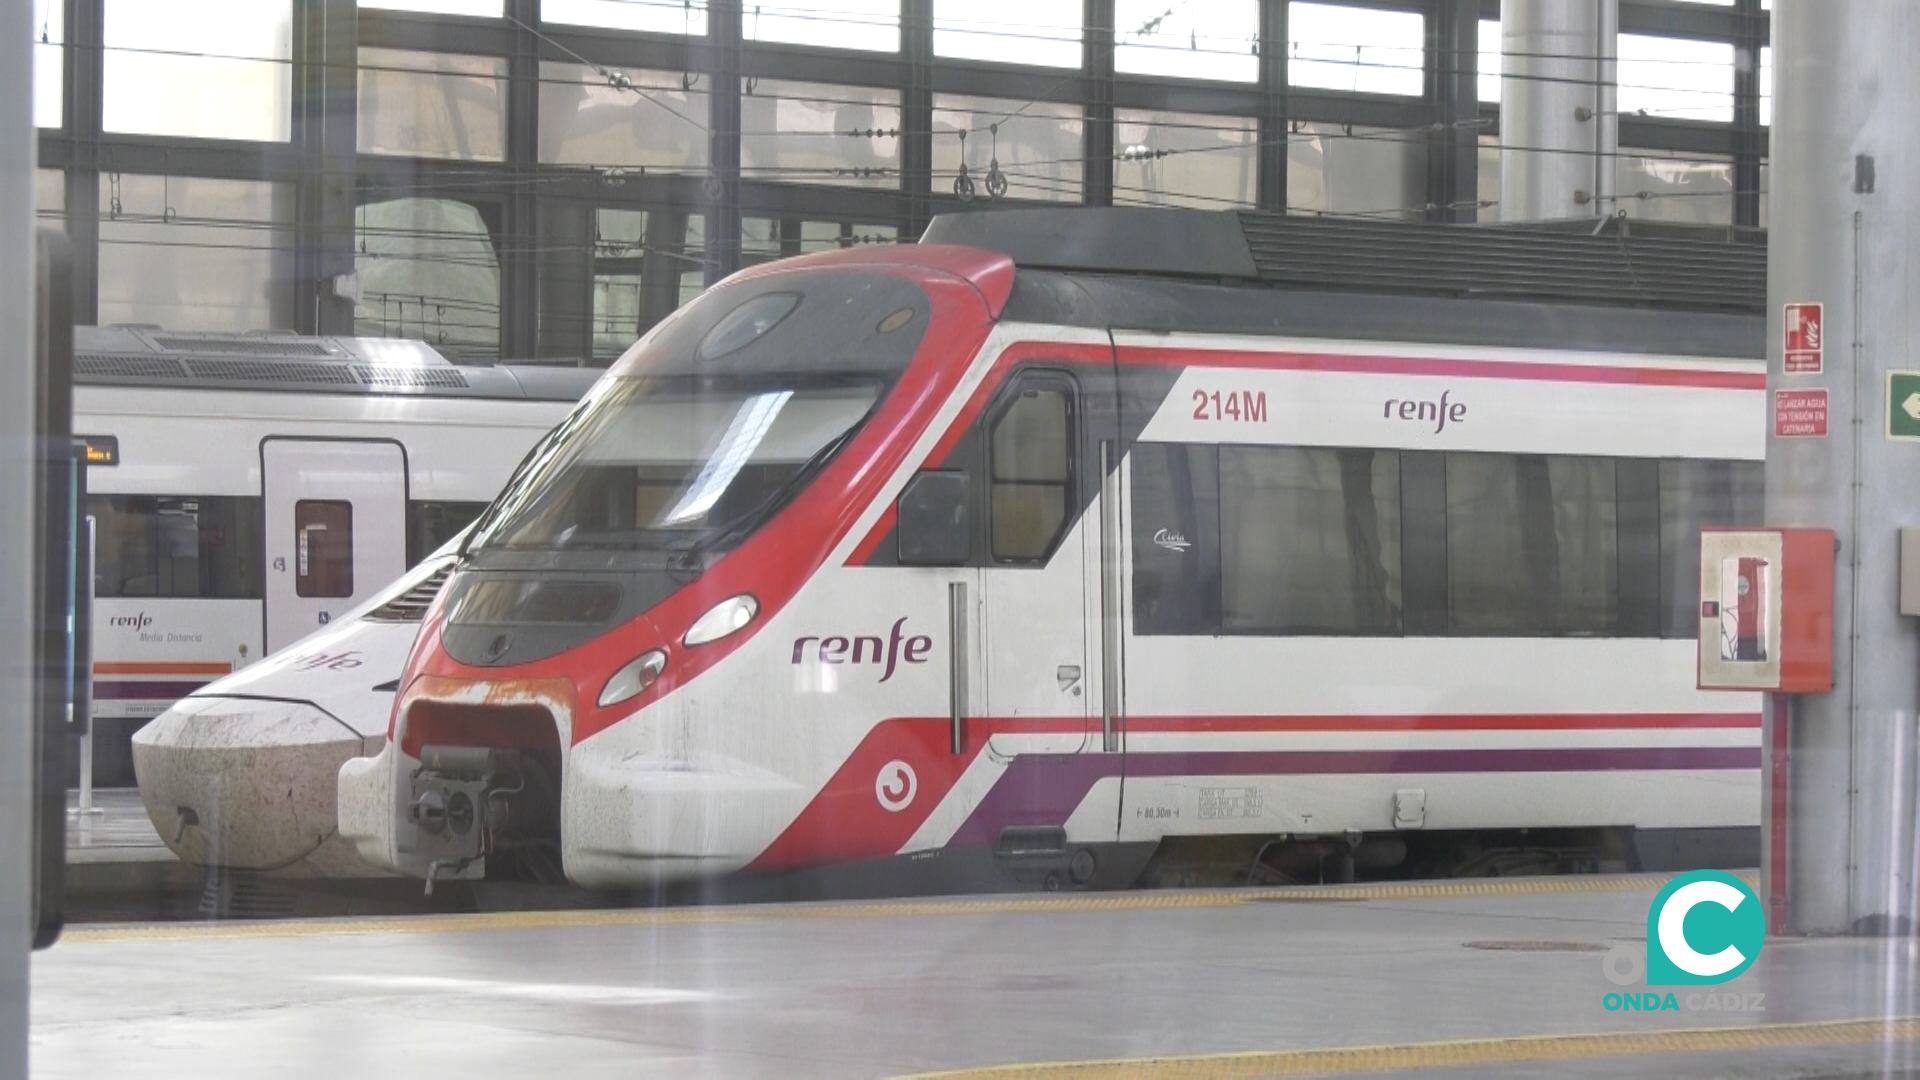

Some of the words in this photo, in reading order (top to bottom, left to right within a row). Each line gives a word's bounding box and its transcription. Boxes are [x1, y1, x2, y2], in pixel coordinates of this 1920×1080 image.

[1192, 389, 1267, 423] 214M
[1384, 389, 1467, 435] renfe
[1807, 398, 1826, 408] AGUA
[110, 610, 153, 632] renfe
[140, 632, 163, 642] Media
[167, 632, 202, 642] Distancia
[791, 616, 932, 683] renfe
